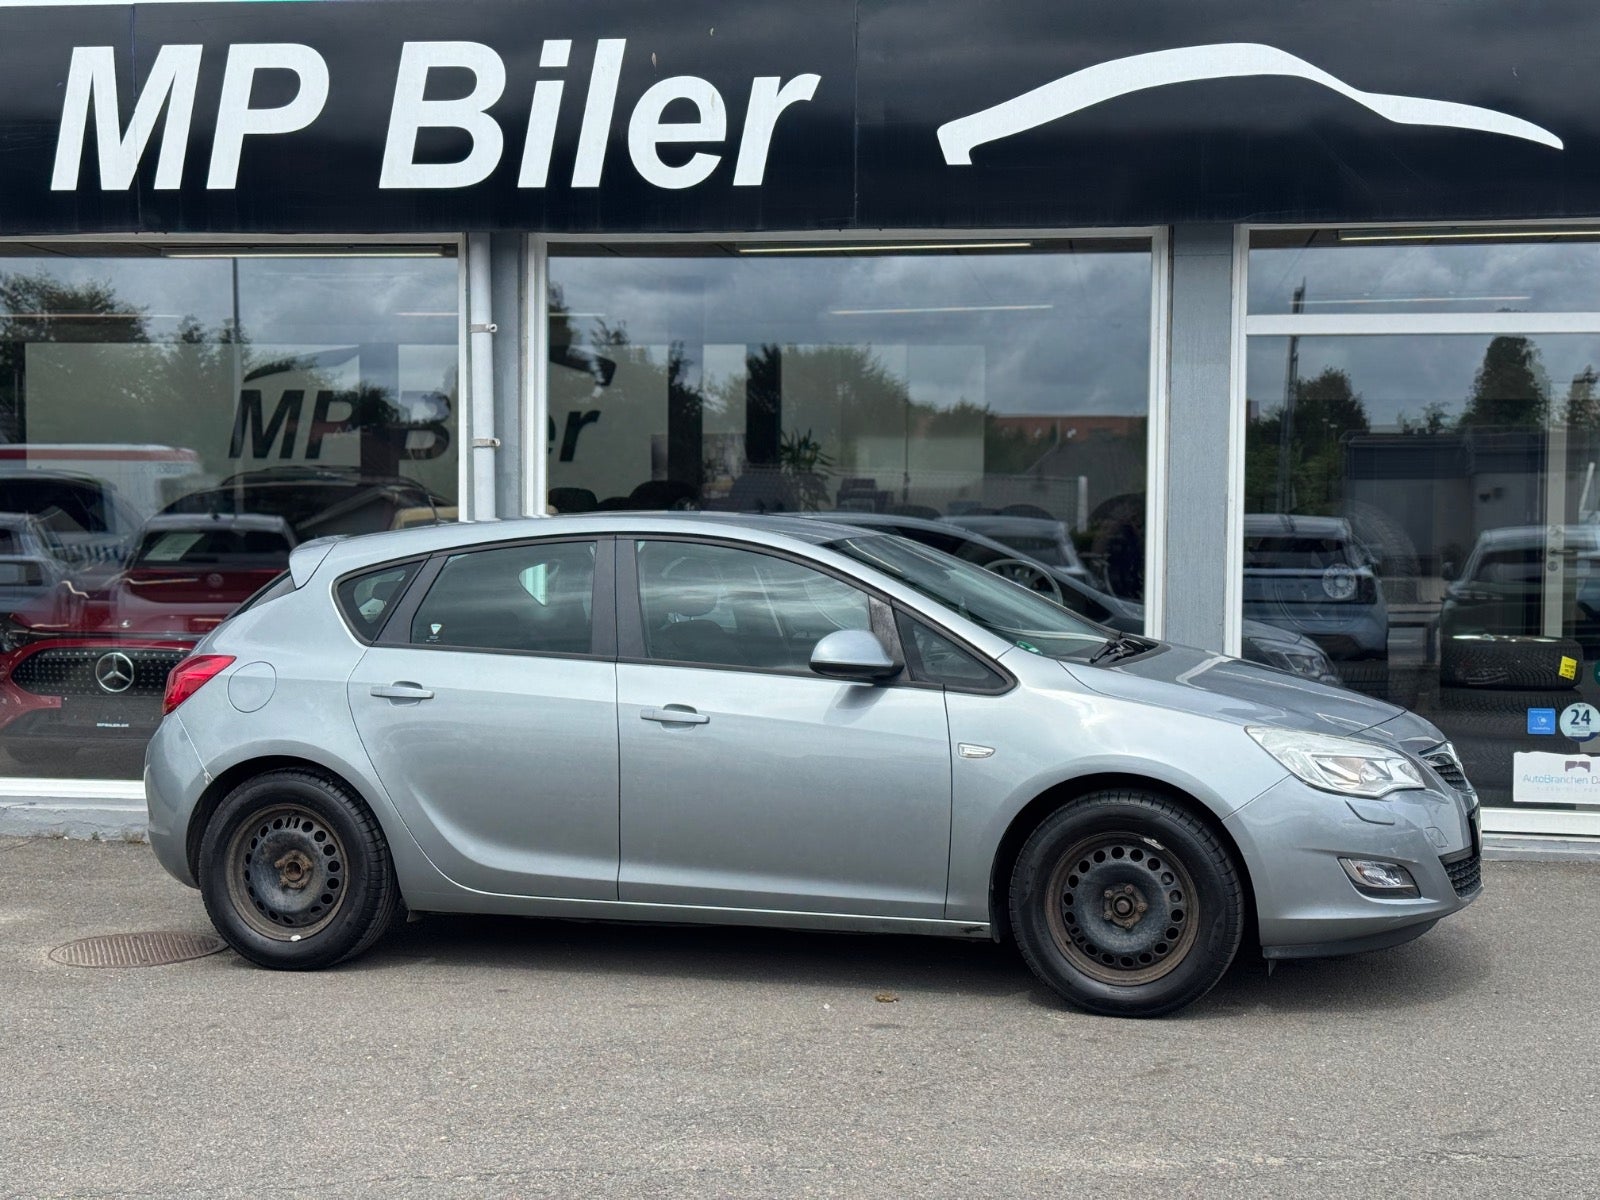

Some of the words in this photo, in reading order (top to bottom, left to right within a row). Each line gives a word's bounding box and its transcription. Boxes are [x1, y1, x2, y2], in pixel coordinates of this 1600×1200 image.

[51, 43, 329, 190] MP
[379, 39, 821, 189] Biler
[229, 390, 365, 459] MP
[1571, 709, 1591, 725] 24
[1523, 774, 1588, 785] AutoBranchen
